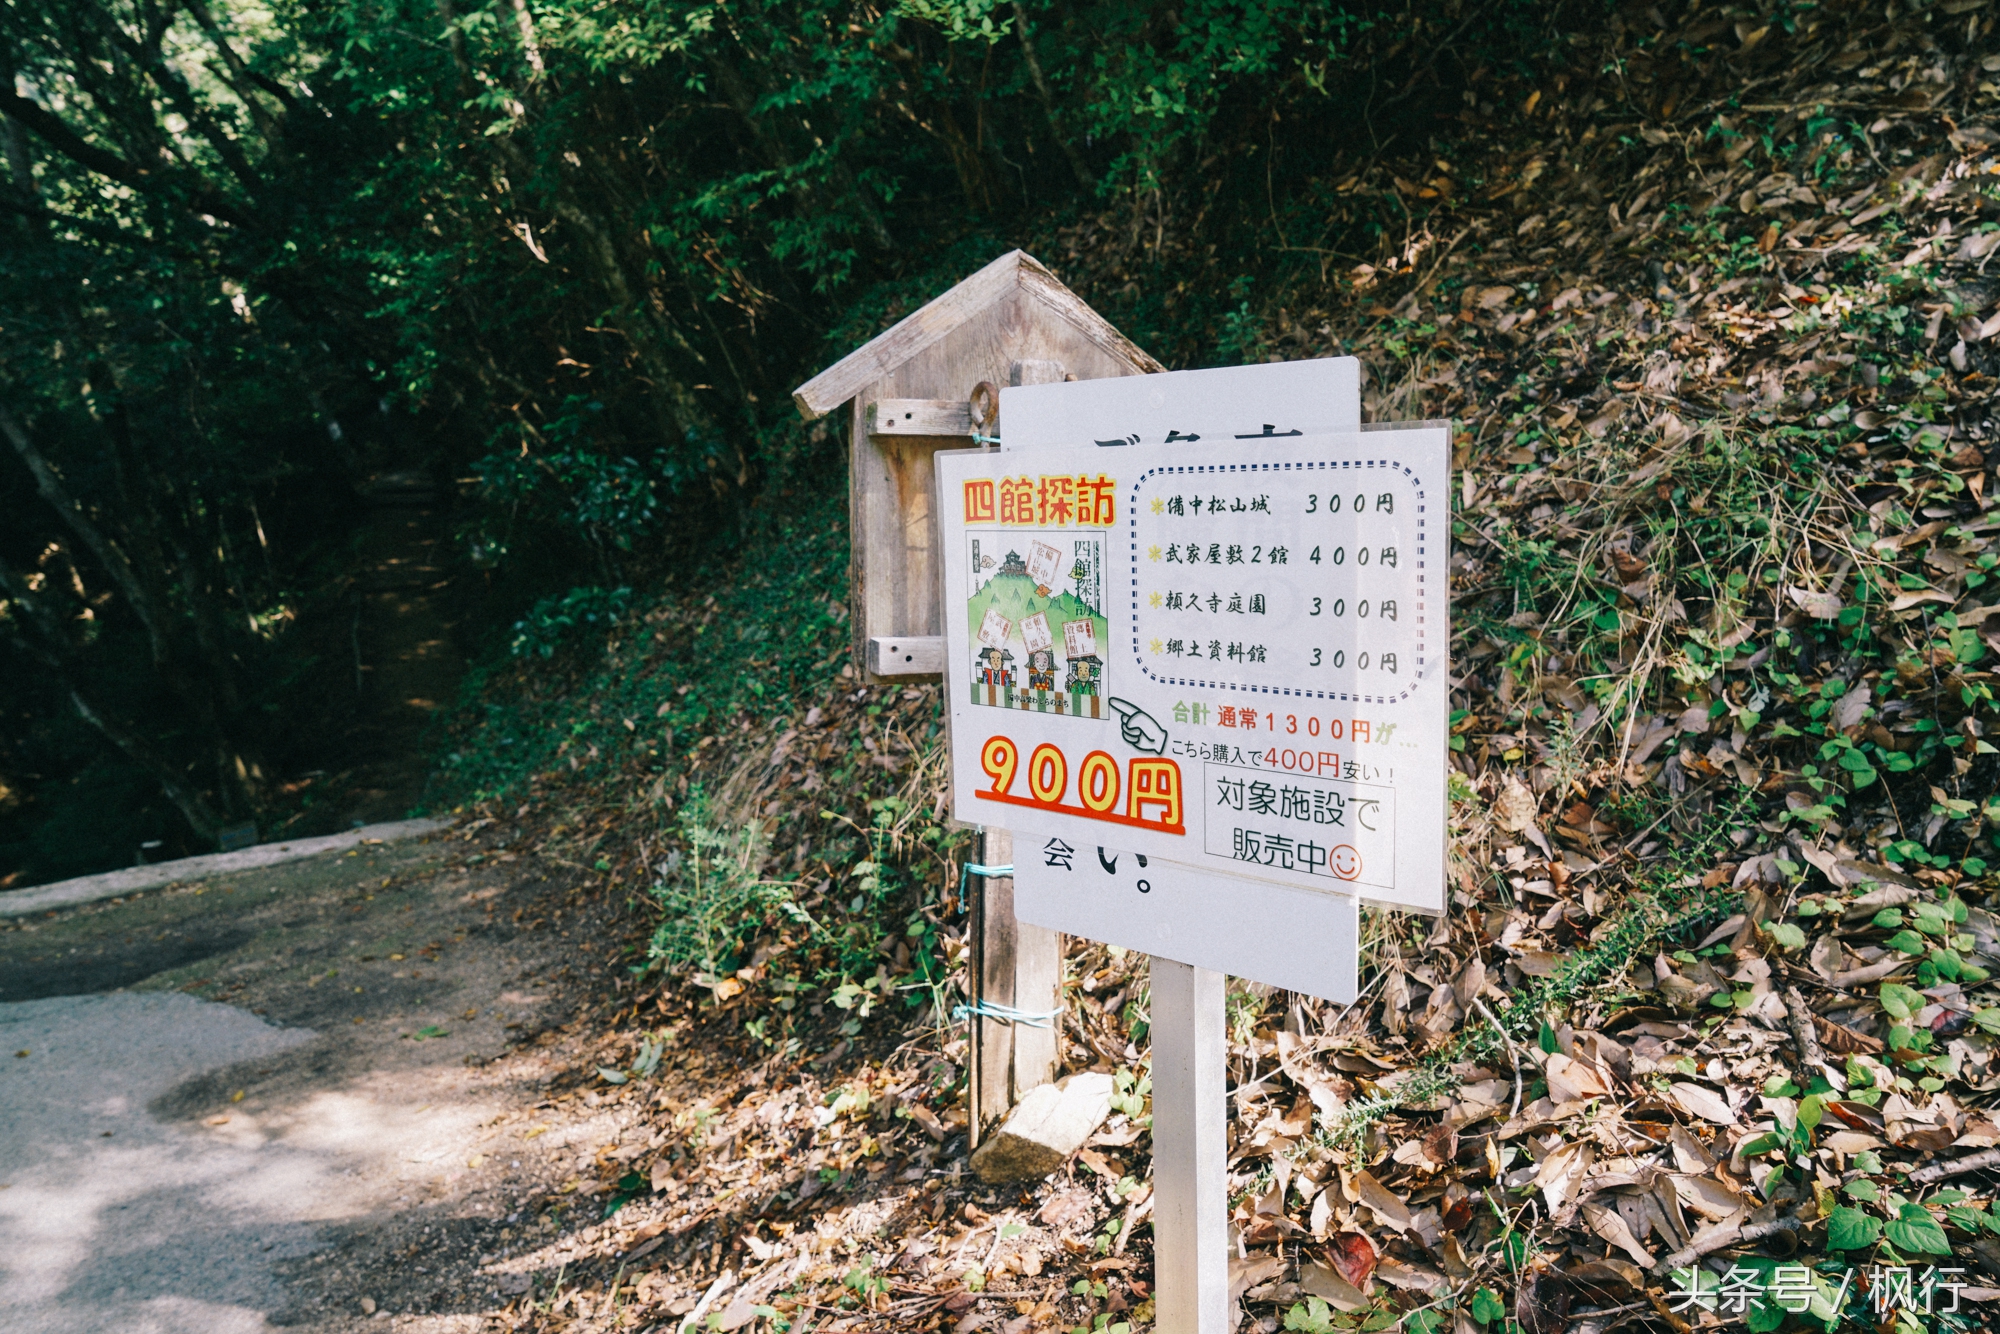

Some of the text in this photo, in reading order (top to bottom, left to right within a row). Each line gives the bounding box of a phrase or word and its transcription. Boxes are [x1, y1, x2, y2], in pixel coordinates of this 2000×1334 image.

[963, 474, 1116, 527] 四館探訪
[1167, 493, 1394, 516] 備中松山城 300円
[1165, 542, 1398, 569] 武家屋敷2館 400円
[1165, 590, 1398, 622] 頼久寺庭園 300円
[1166, 638, 1398, 674] 郷土資料館 300円
[1171, 700, 1211, 726] 合計
[981, 735, 1184, 826] 900円
[1216, 775, 1380, 832] 対象施設で
[1042, 837, 1075, 872] 会
[1233, 827, 1327, 874] 販売中
